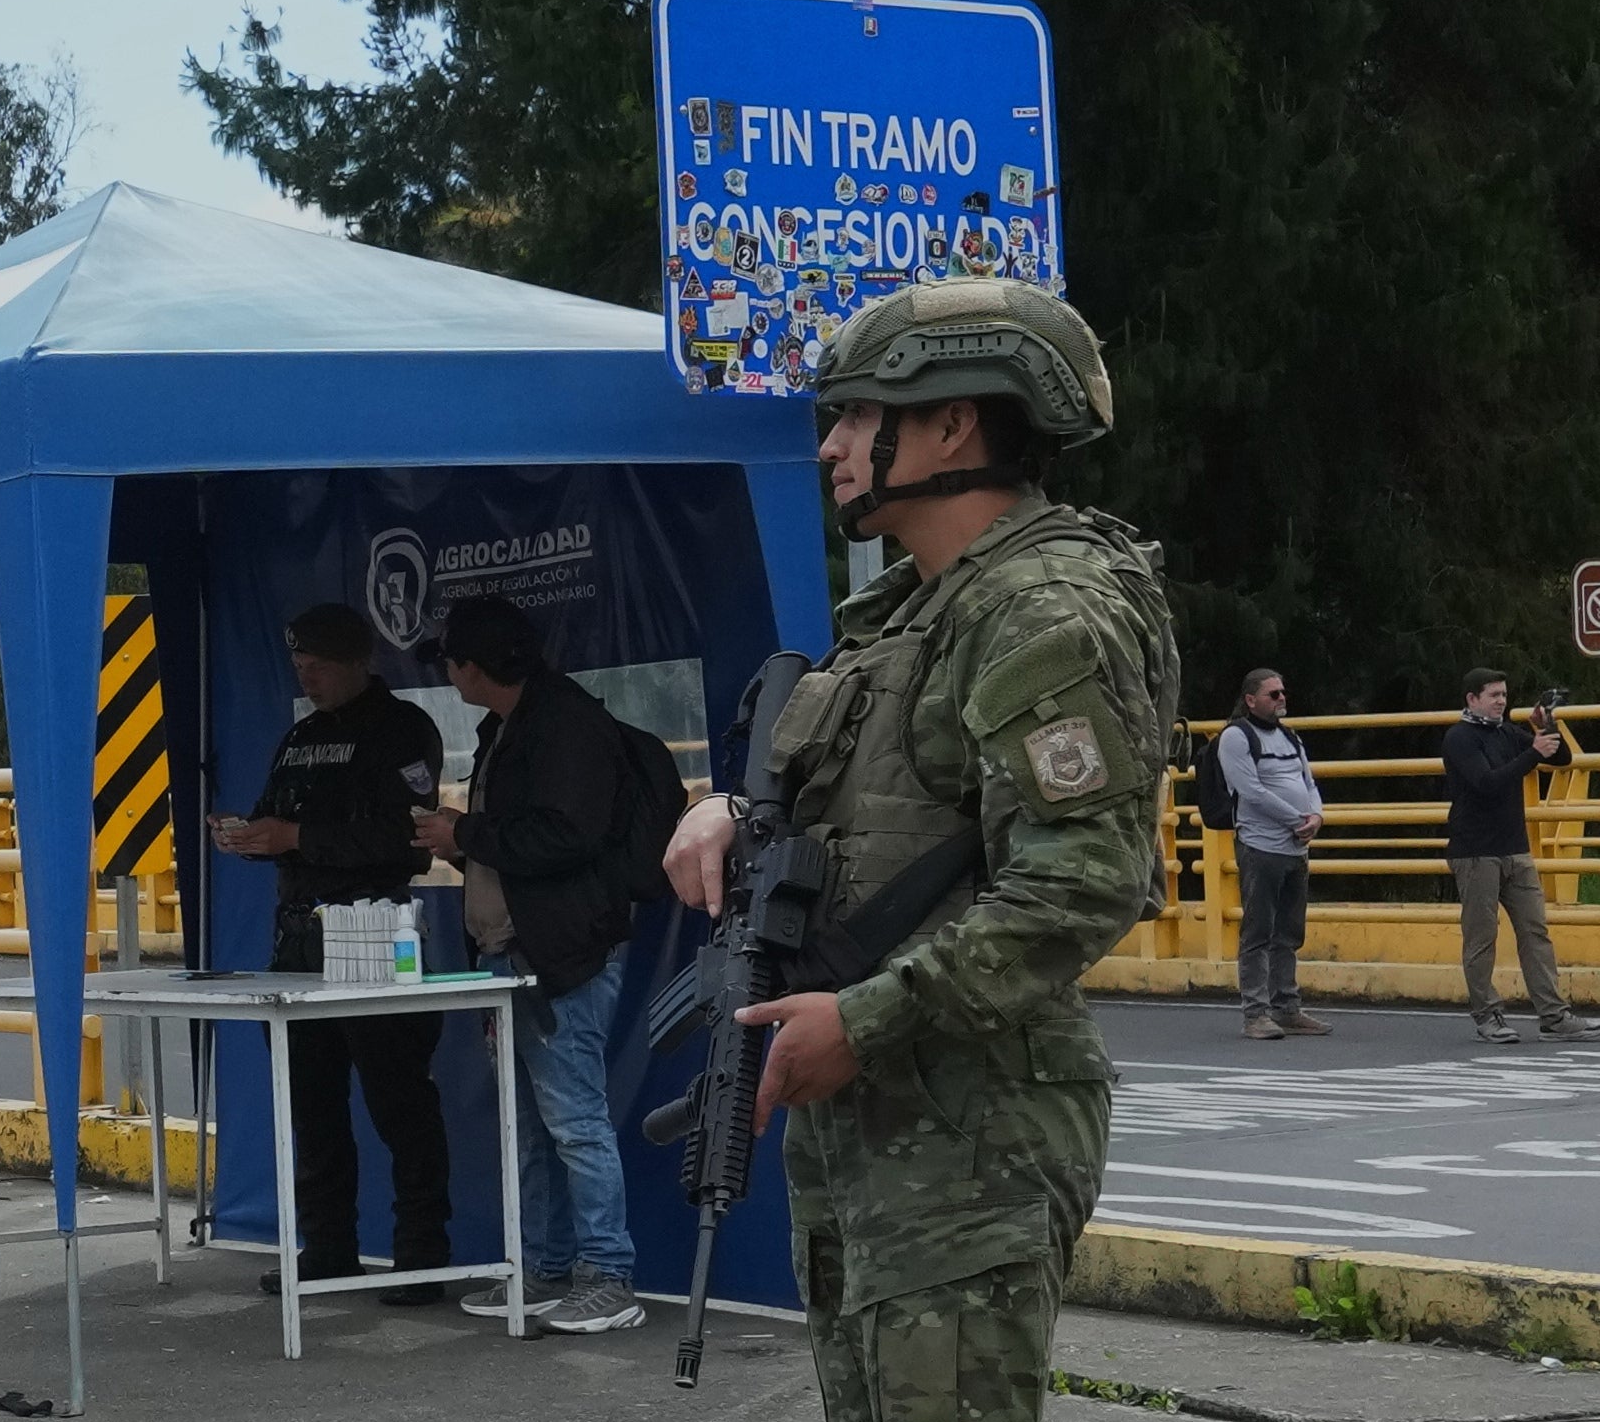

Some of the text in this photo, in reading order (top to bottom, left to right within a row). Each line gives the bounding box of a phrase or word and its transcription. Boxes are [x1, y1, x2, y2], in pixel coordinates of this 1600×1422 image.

[740, 105, 977, 177] FIN TRAMO
[434, 523, 591, 573] AGROCALIDAD
[486, 580, 500, 594] DE
